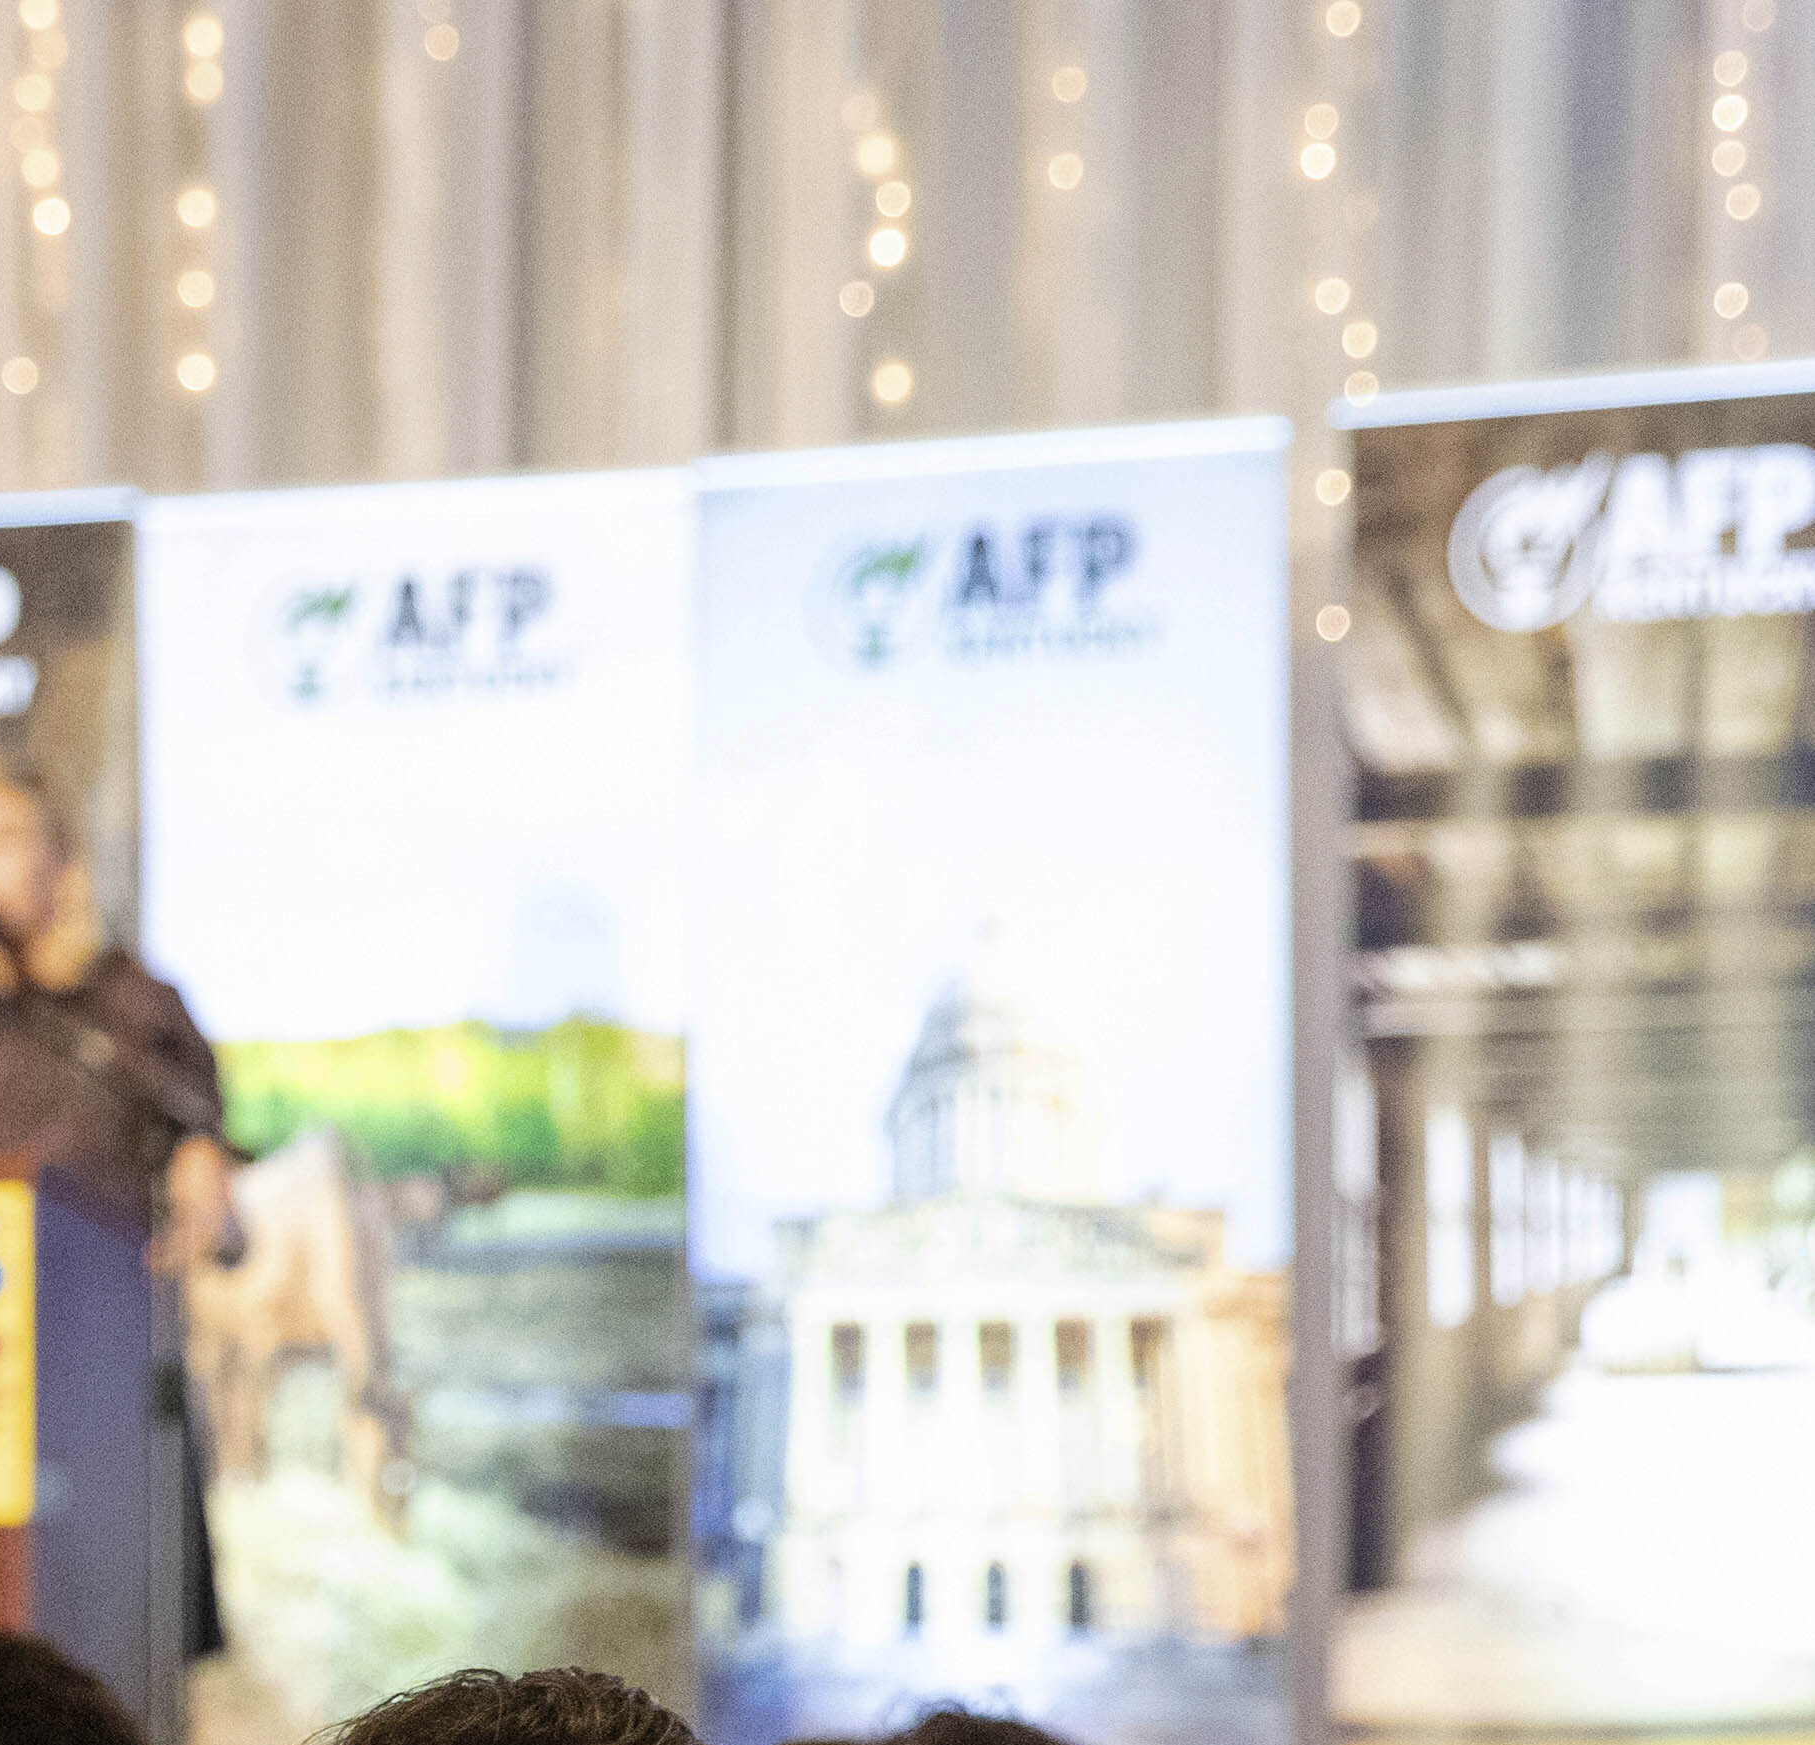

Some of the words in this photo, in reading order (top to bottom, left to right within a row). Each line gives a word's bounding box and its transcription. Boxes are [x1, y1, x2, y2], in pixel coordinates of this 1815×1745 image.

[1597, 444, 1815, 574] AFP
[954, 512, 1139, 607] AFP
[376, 566, 555, 650] AFP
